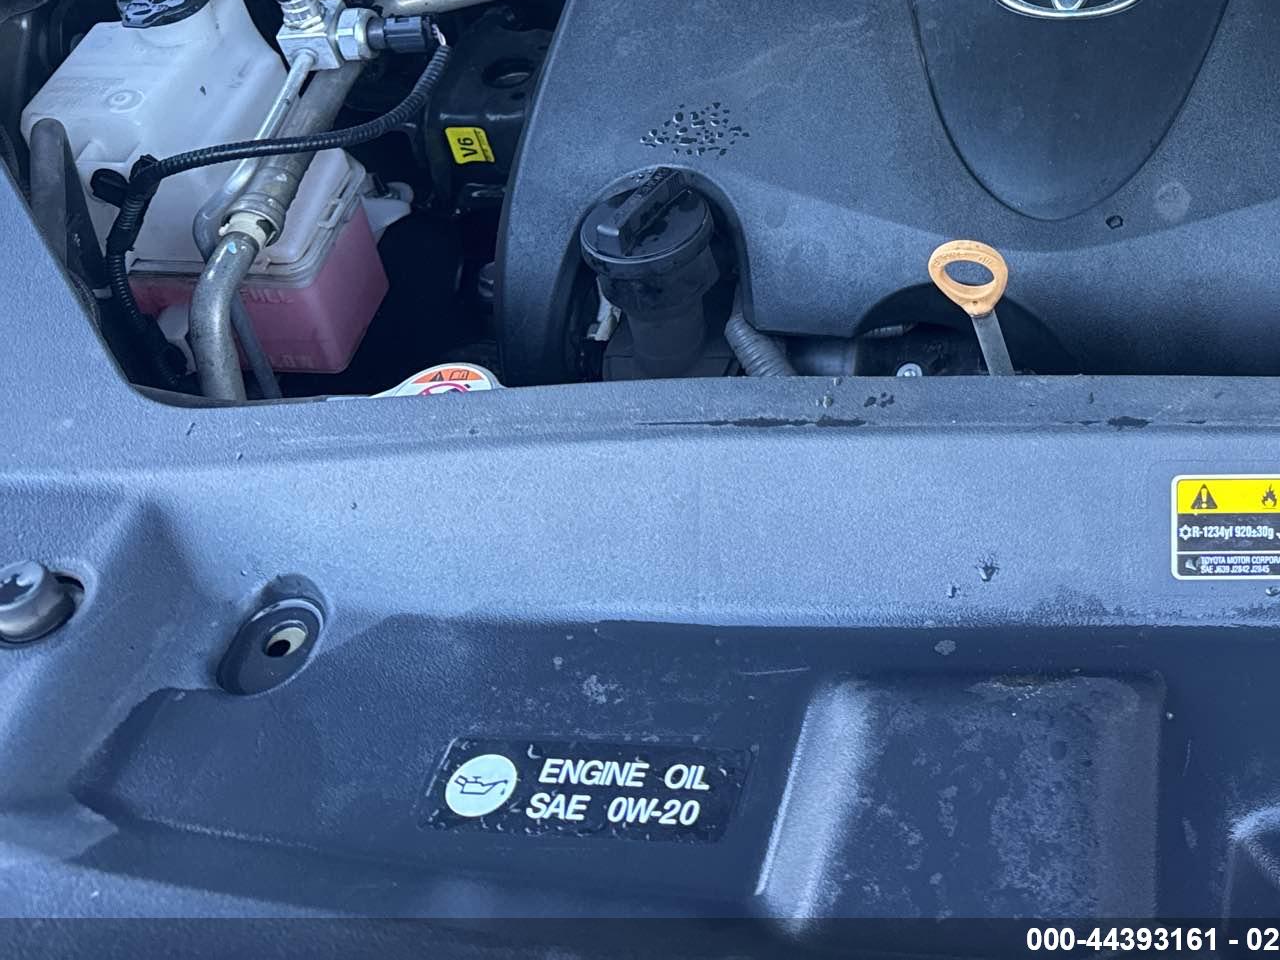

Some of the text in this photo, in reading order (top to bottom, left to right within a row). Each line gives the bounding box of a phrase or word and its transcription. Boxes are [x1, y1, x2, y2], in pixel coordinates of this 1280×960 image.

[457, 137, 479, 158] V6
[1192, 525, 1233, 540] R-1234yf
[1234, 525, 1274, 540] 920±30g
[1200, 565, 1213, 573] SAE
[1201, 556, 1226, 564] TOYOTA
[1227, 556, 1250, 564] MOTOR
[538, 758, 711, 790] ENGINE OIL
[525, 793, 700, 826] SAE 0W-20
